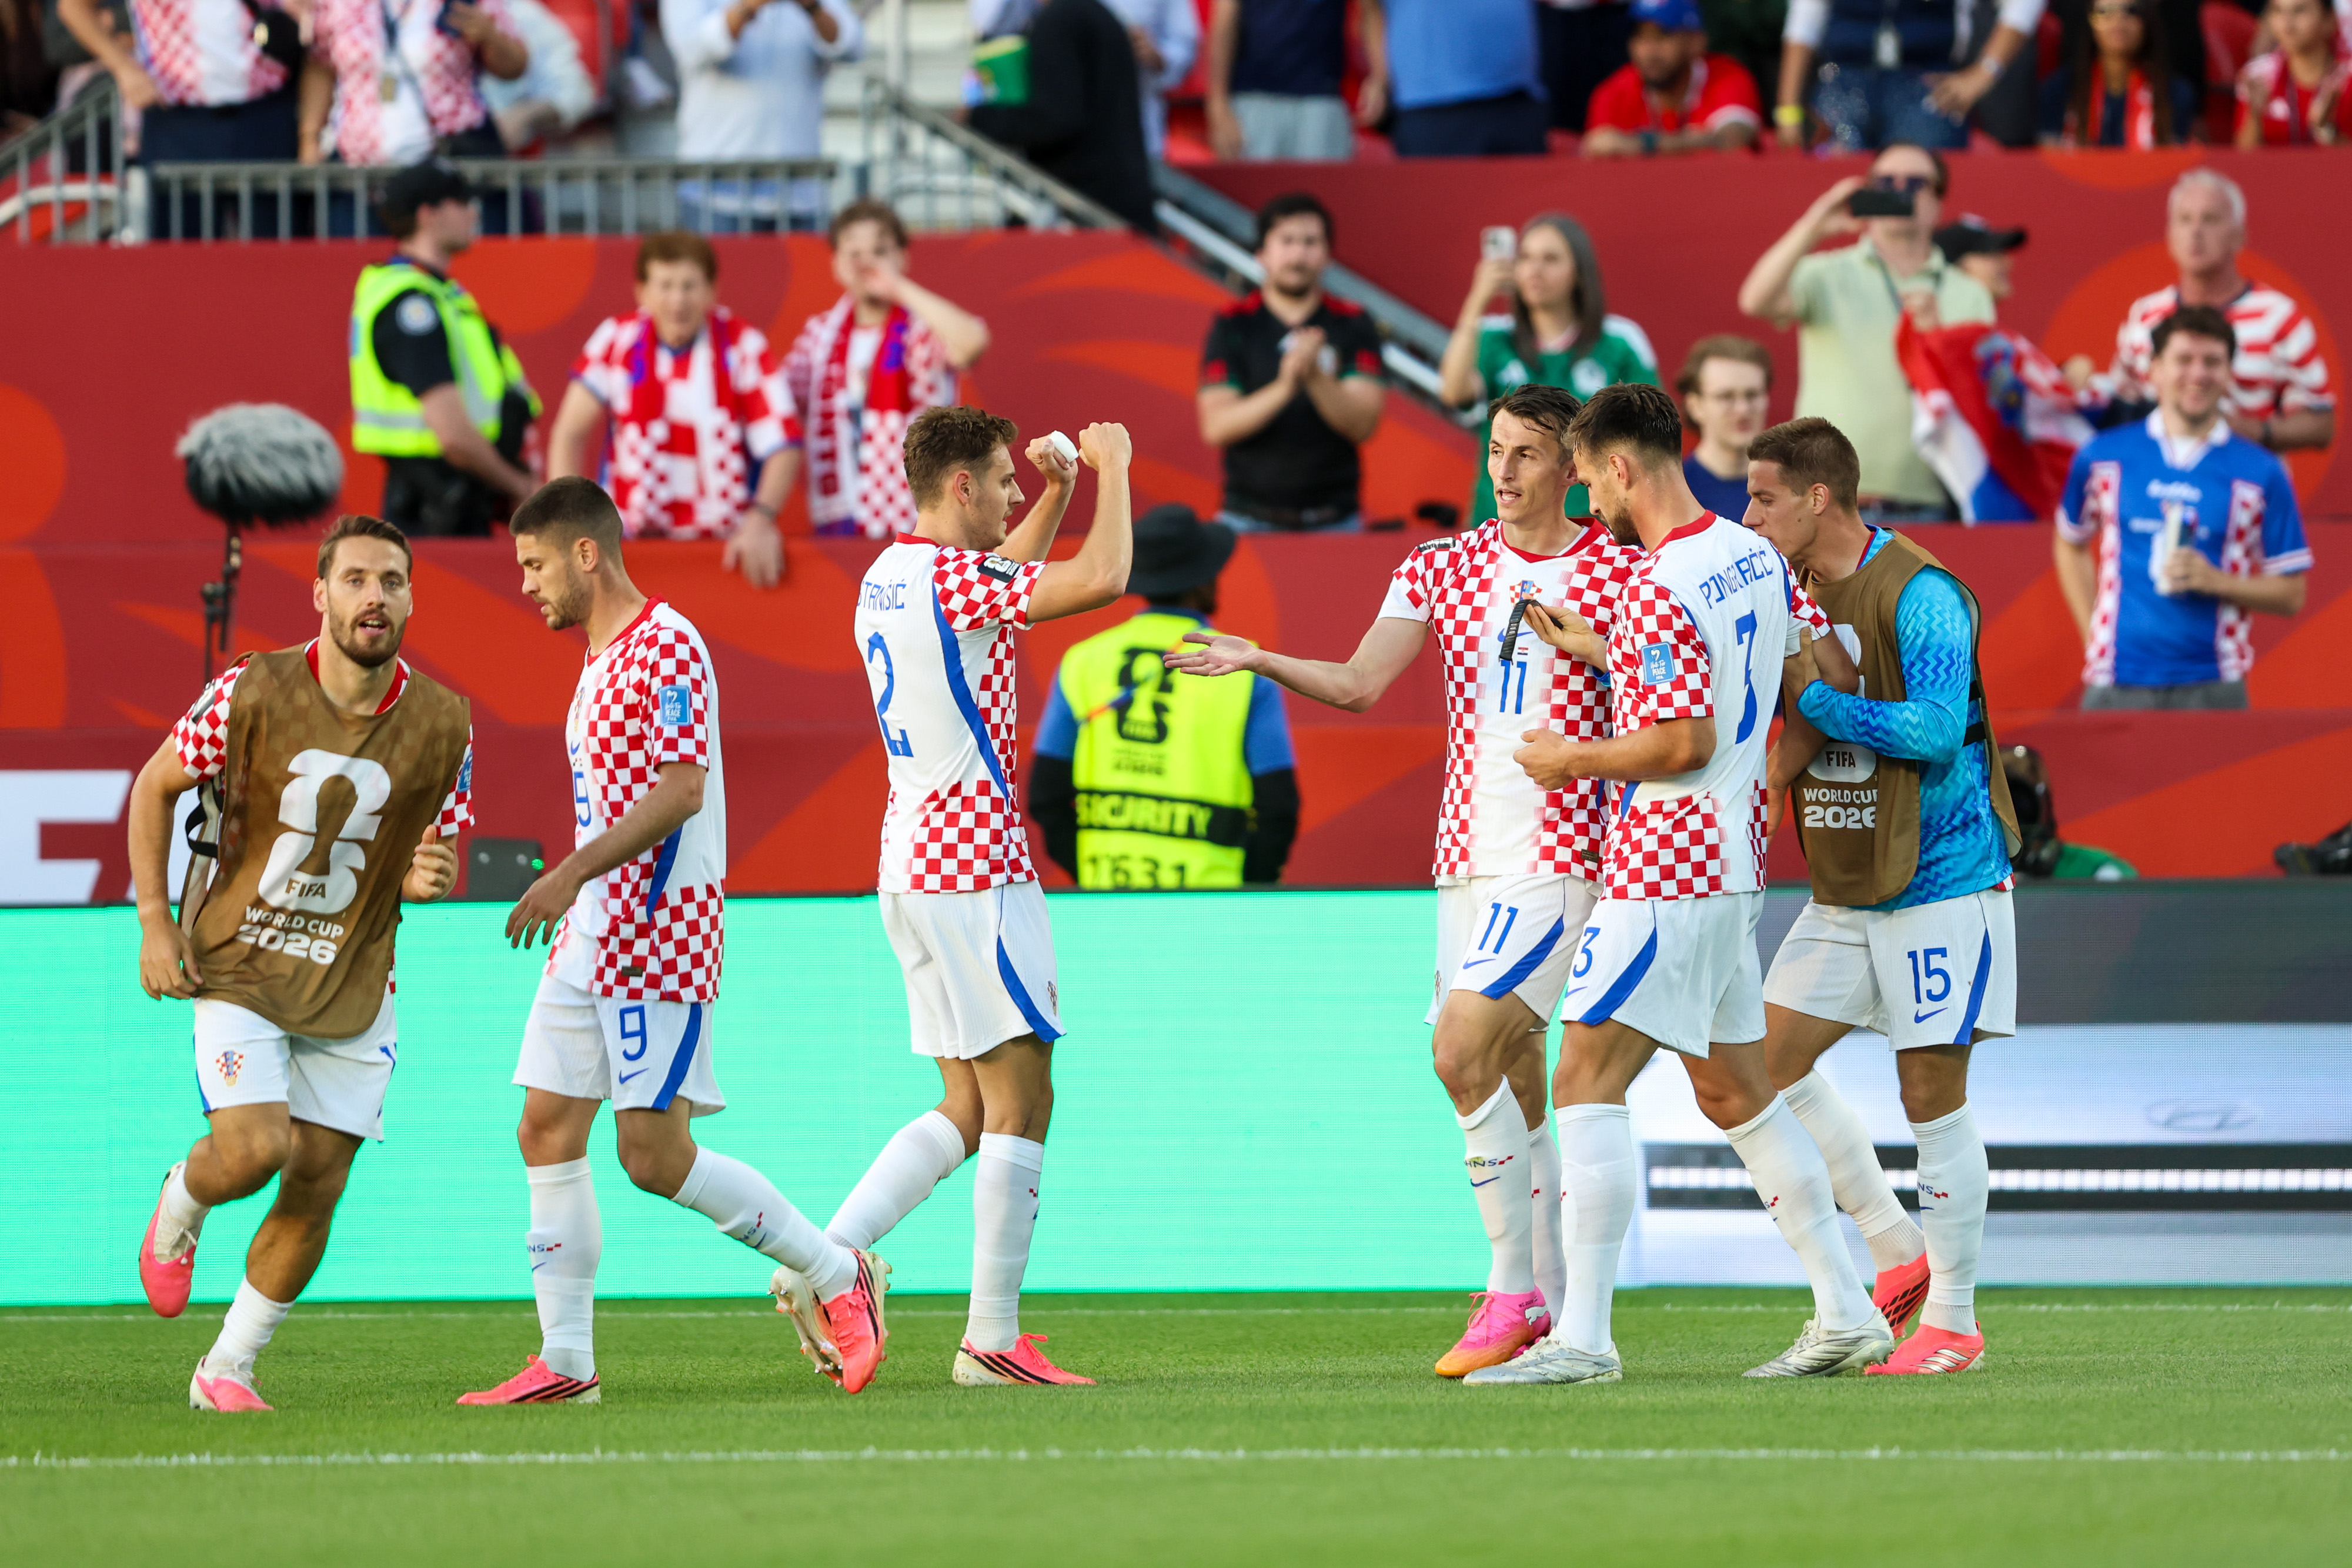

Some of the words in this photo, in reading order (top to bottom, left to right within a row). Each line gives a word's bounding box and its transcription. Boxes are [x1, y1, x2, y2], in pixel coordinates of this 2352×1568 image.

[868, 631, 914, 757] 2
[1500, 660, 1527, 714] 11
[1826, 751, 1856, 768] FIFA
[574, 771, 592, 827] 9
[1803, 788, 1851, 803] WORLD
[285, 878, 326, 898] FIFA
[235, 924, 338, 965] 2026
[245, 905, 305, 930] WORLD
[307, 920, 345, 940] CUP
[1478, 902, 1519, 955] 11
[1573, 927, 1601, 978] 3
[1907, 947, 1951, 1004] 15
[619, 1004, 647, 1061] 9
[527, 1243, 545, 1252] NS
